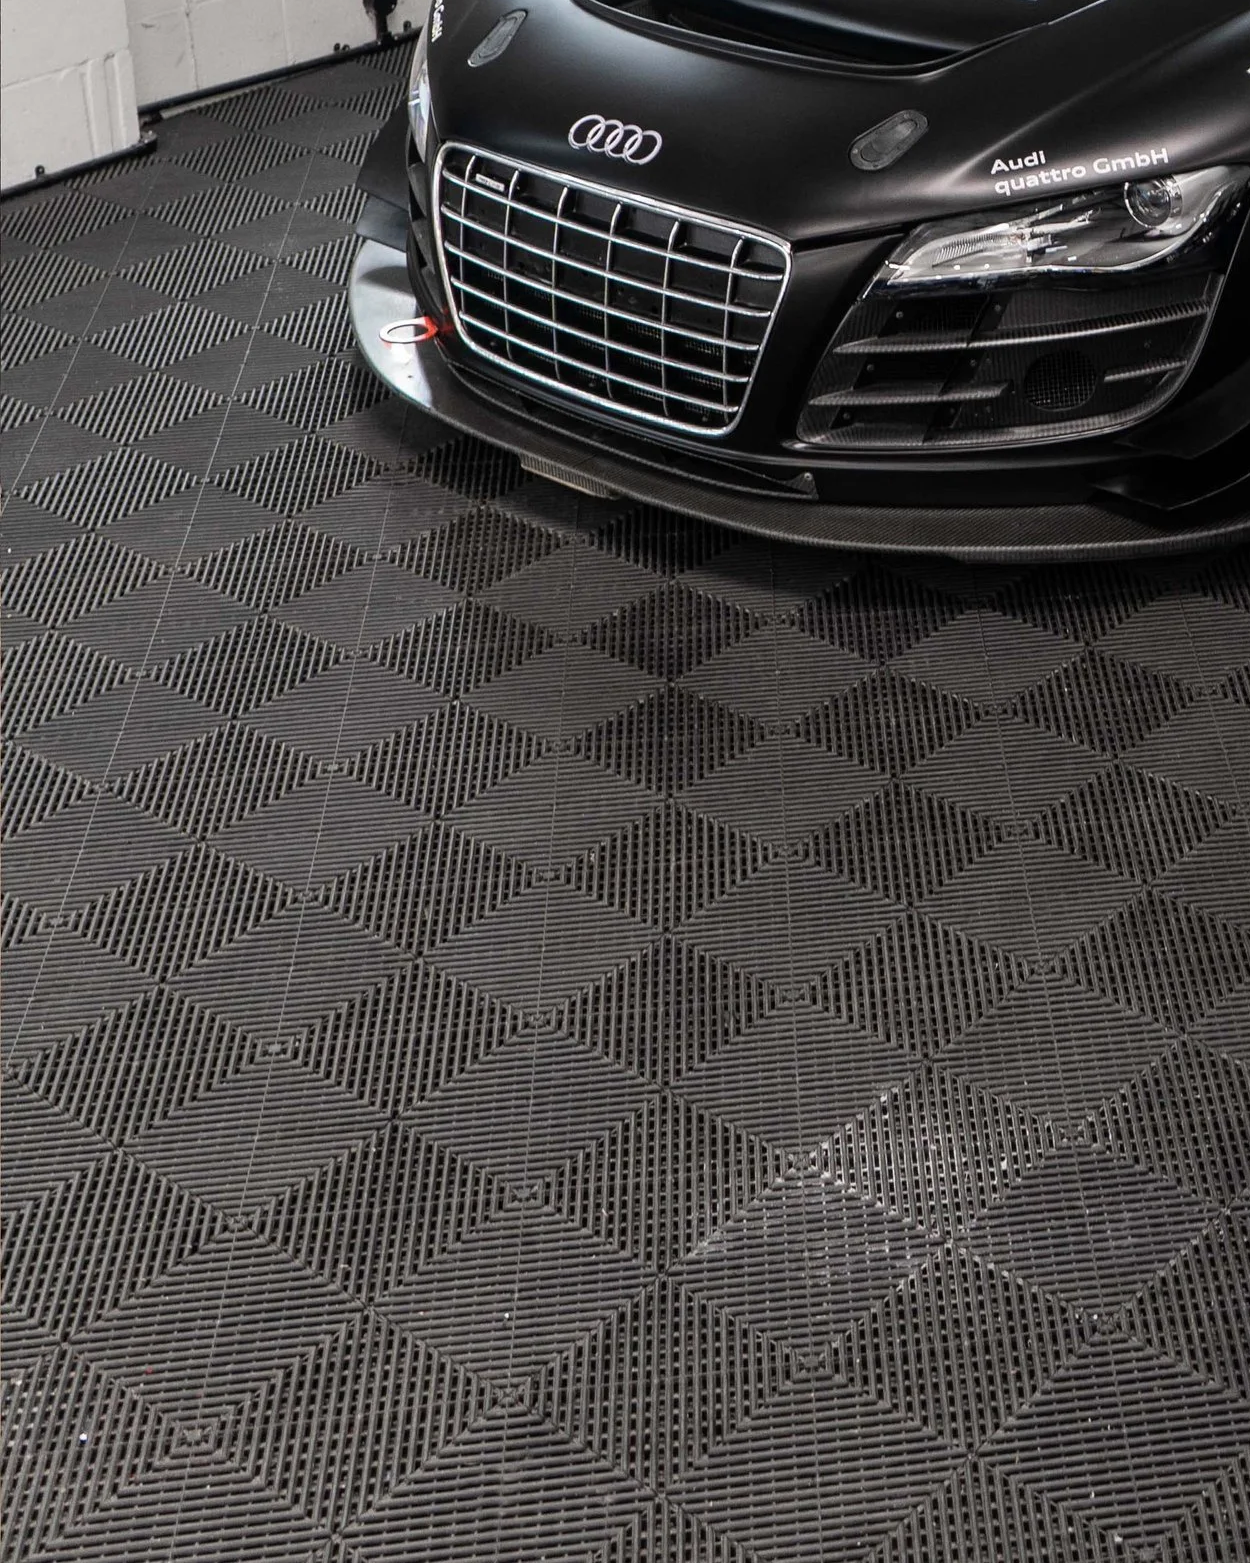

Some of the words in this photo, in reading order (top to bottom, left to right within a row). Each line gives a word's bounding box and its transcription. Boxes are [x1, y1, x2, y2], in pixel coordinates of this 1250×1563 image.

[990, 150, 1047, 175] Audi
[994, 164, 1087, 197] quattro
[1092, 147, 1169, 175] GmbH
